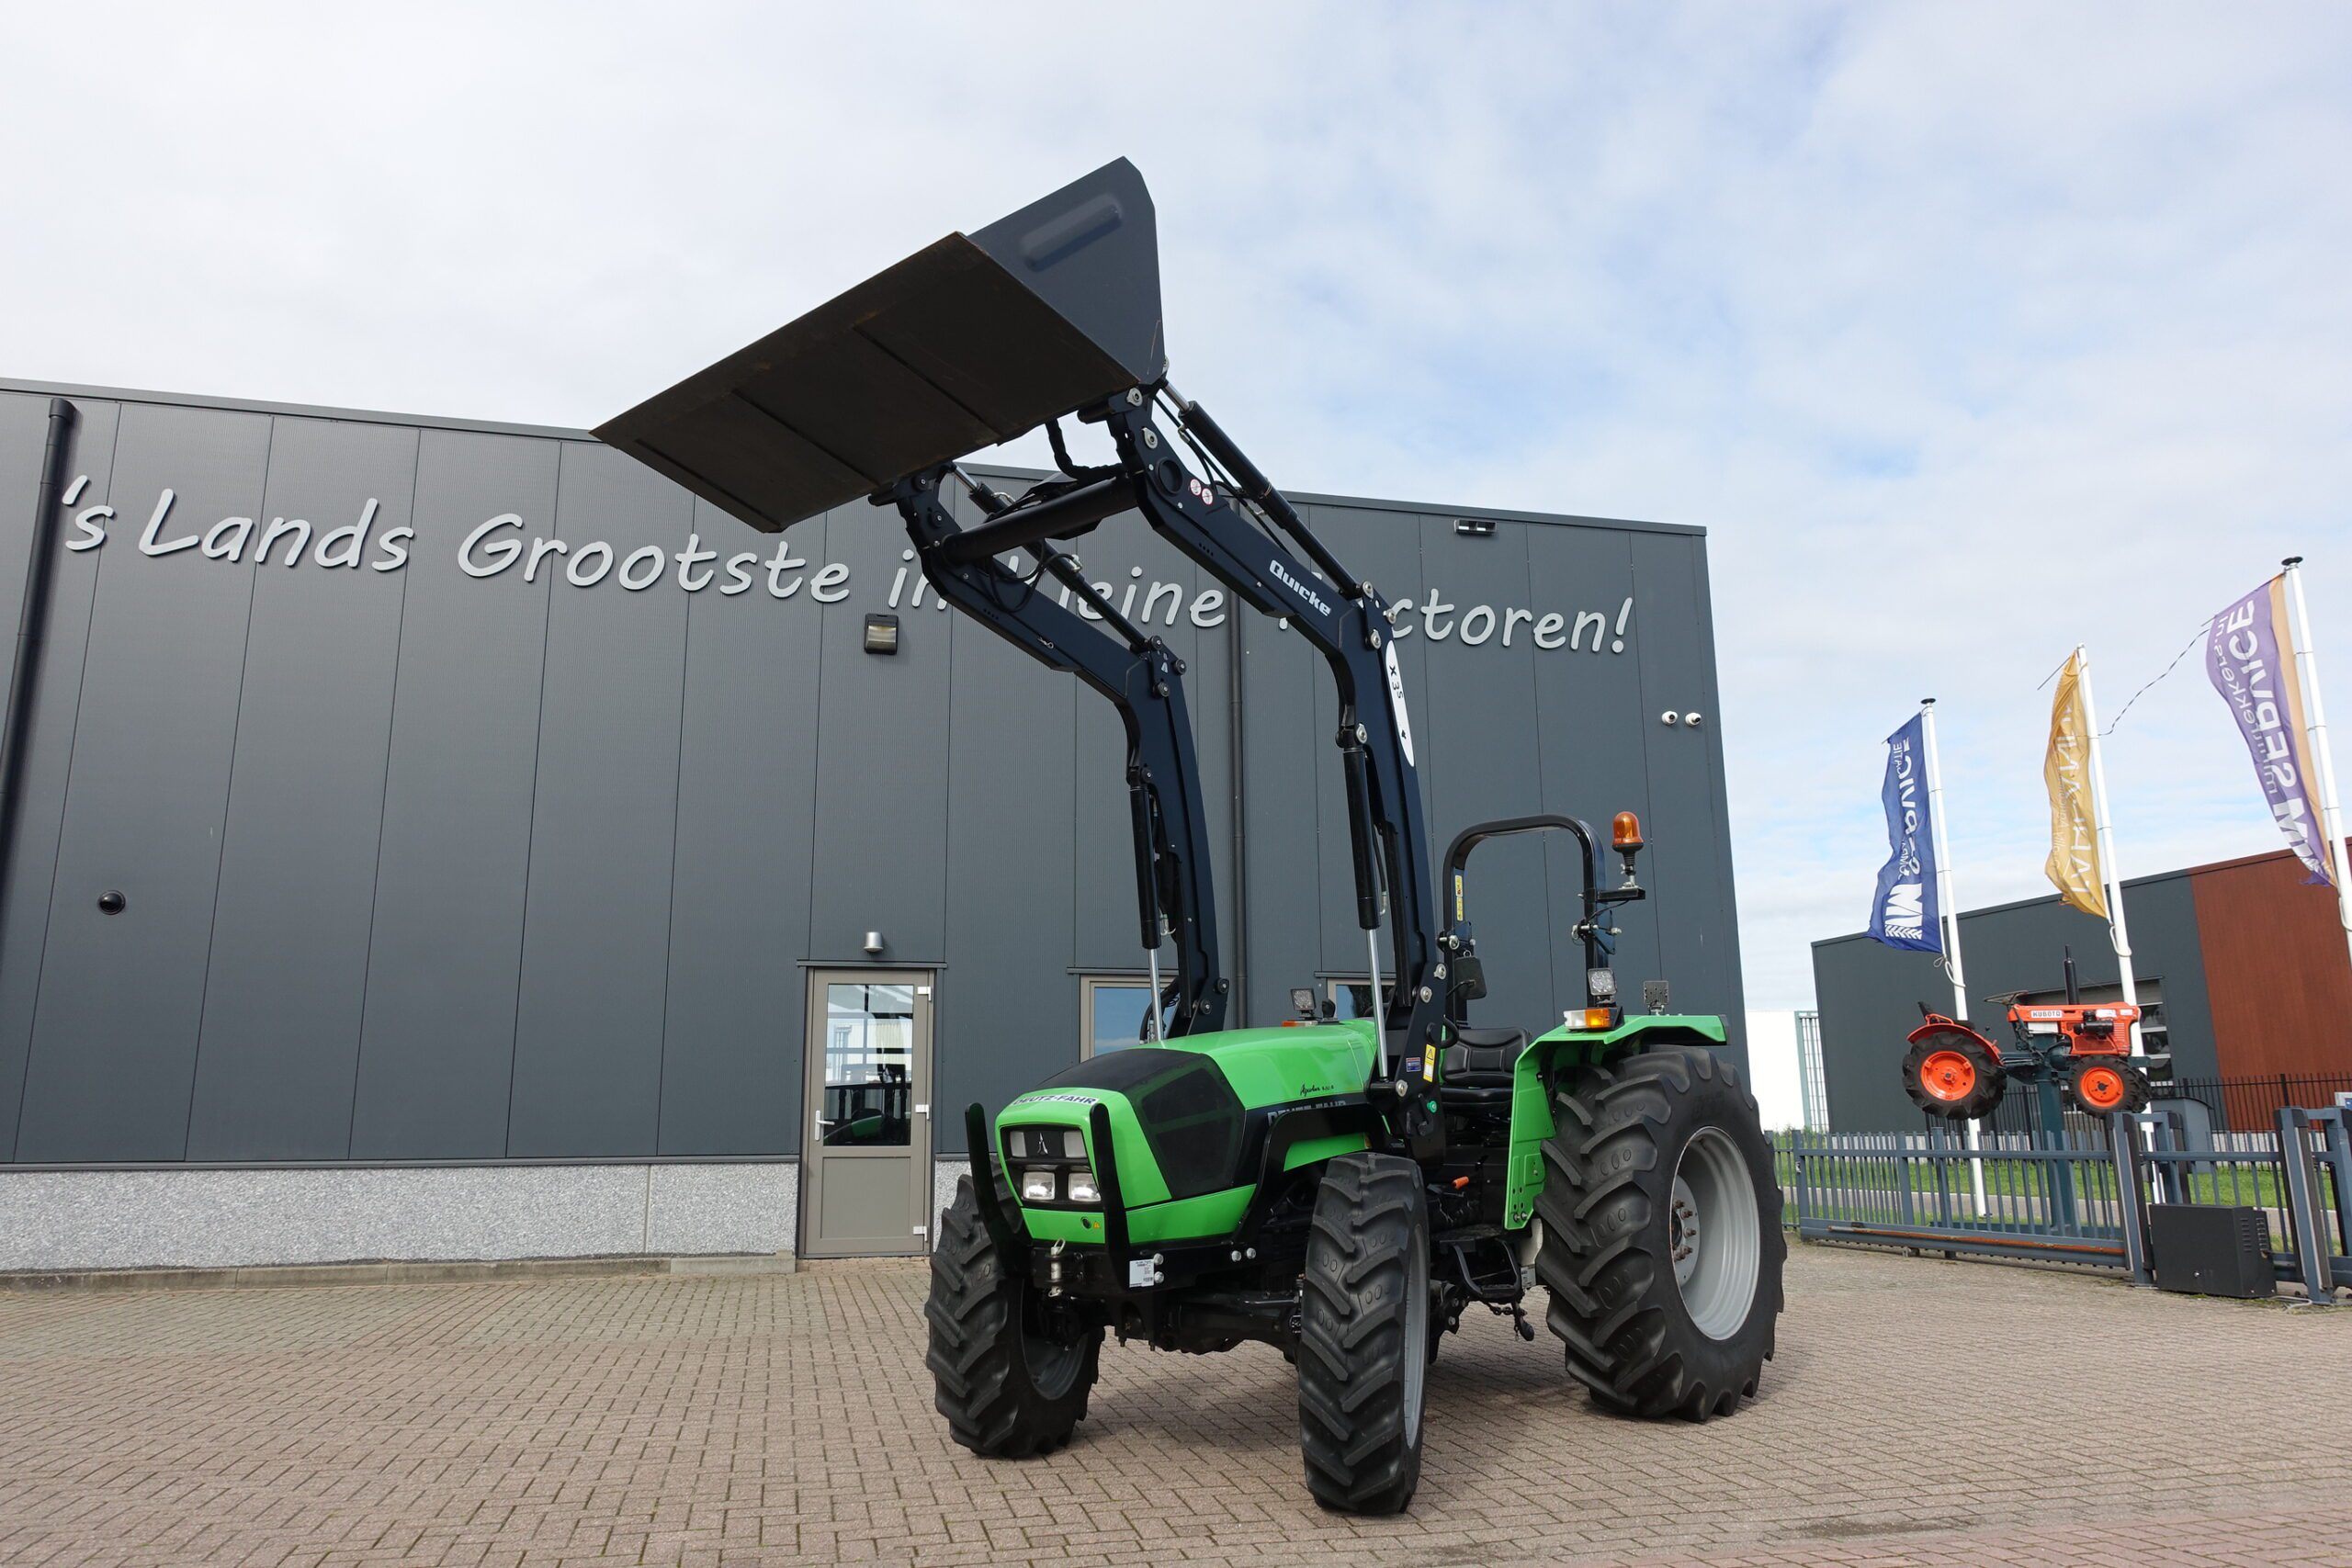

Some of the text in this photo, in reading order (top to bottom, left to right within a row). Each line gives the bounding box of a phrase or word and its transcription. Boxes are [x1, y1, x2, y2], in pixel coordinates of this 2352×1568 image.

[62, 474, 114, 550] 's
[138, 488, 414, 570] Lands
[458, 513, 851, 604] Grootste
[1008, 555, 1226, 628] eine
[1279, 571, 1634, 654] ctoren!
[1269, 559, 1331, 616] Quicke
[1013, 1095, 1096, 1105] DEUTZ-FAHR
